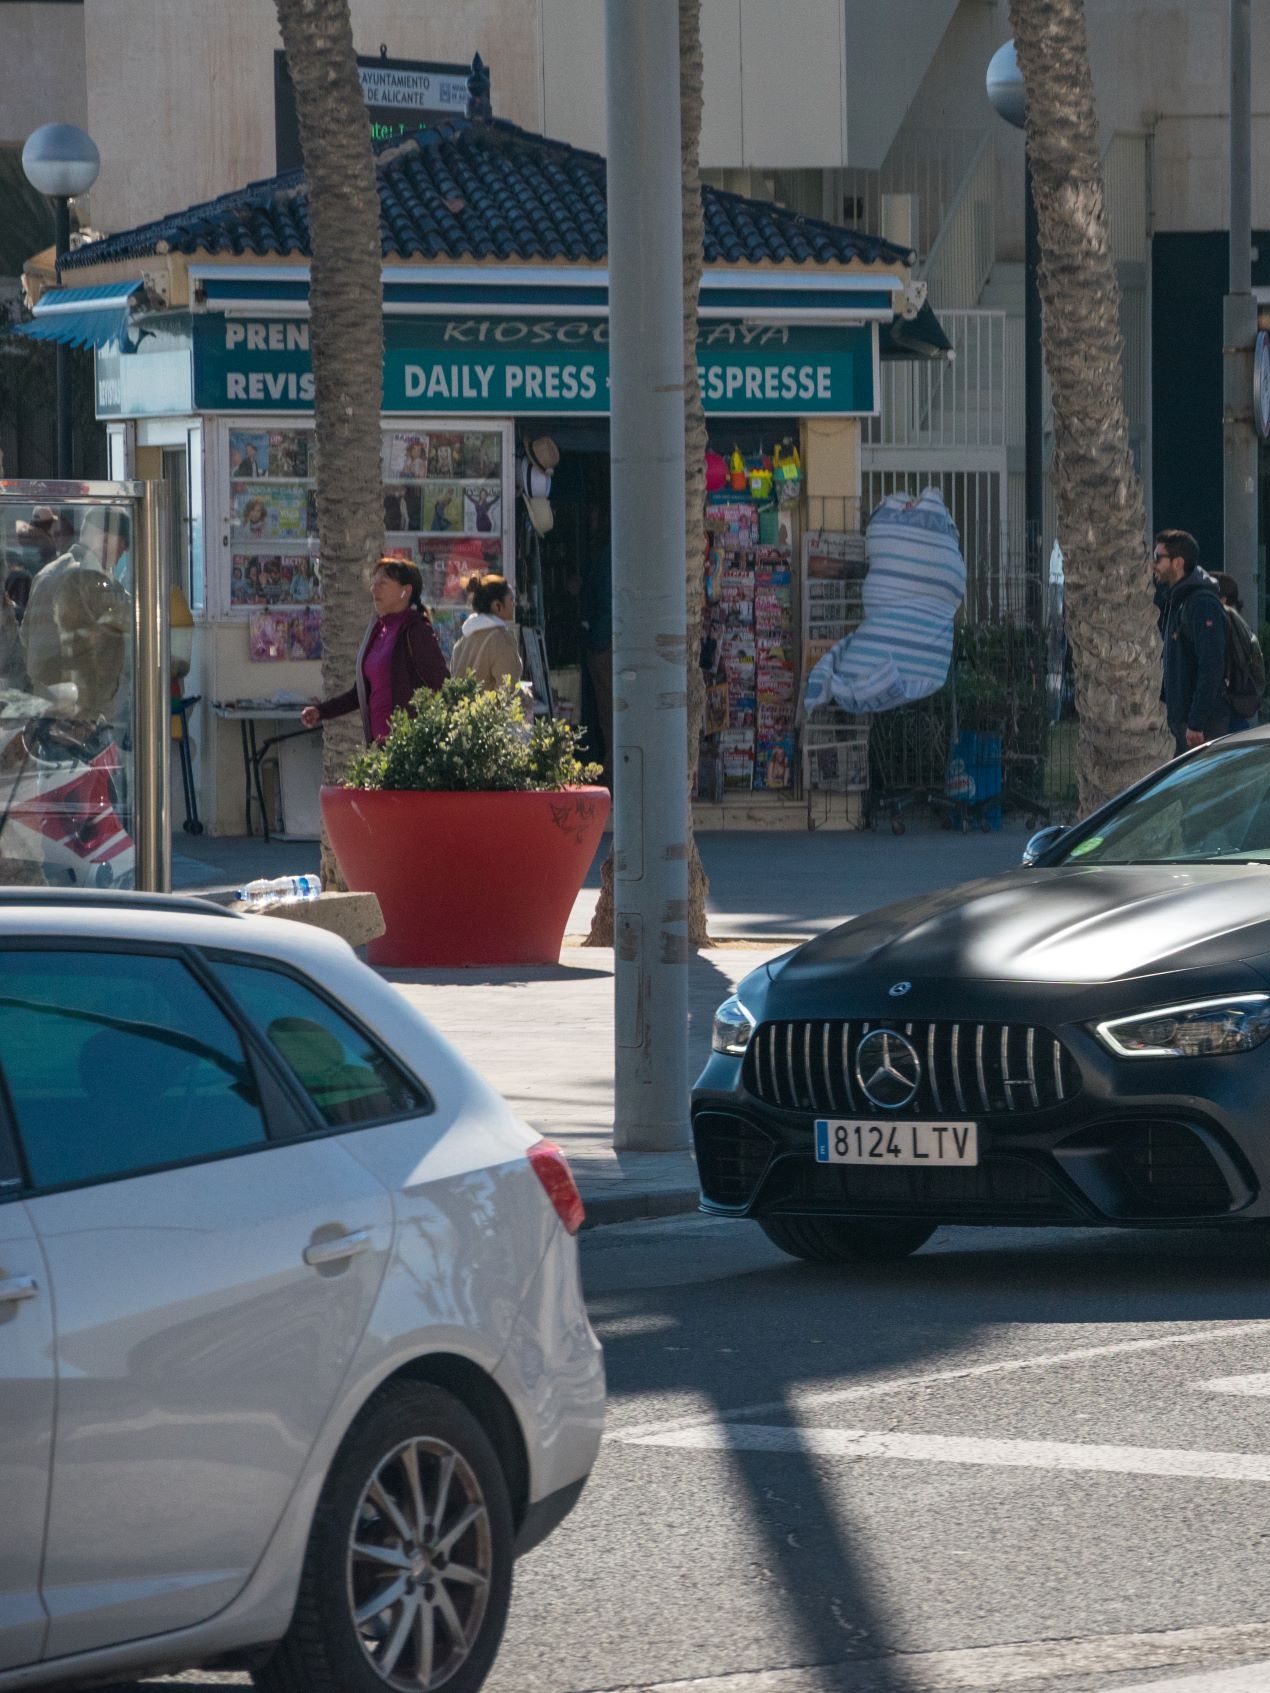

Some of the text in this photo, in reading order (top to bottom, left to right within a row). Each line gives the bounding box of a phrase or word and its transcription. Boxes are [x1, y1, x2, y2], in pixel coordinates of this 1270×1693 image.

[362, 71, 430, 90] AYUNTAMIENTO
[367, 88, 425, 106] DE ALICANTE
[225, 322, 310, 350] PREN
[697, 323, 789, 345] AYA
[226, 372, 315, 400] REVIS
[404, 364, 495, 398] DAILY
[505, 365, 597, 399] PRESS
[834, 1125, 969, 1159] 8124 LTV
